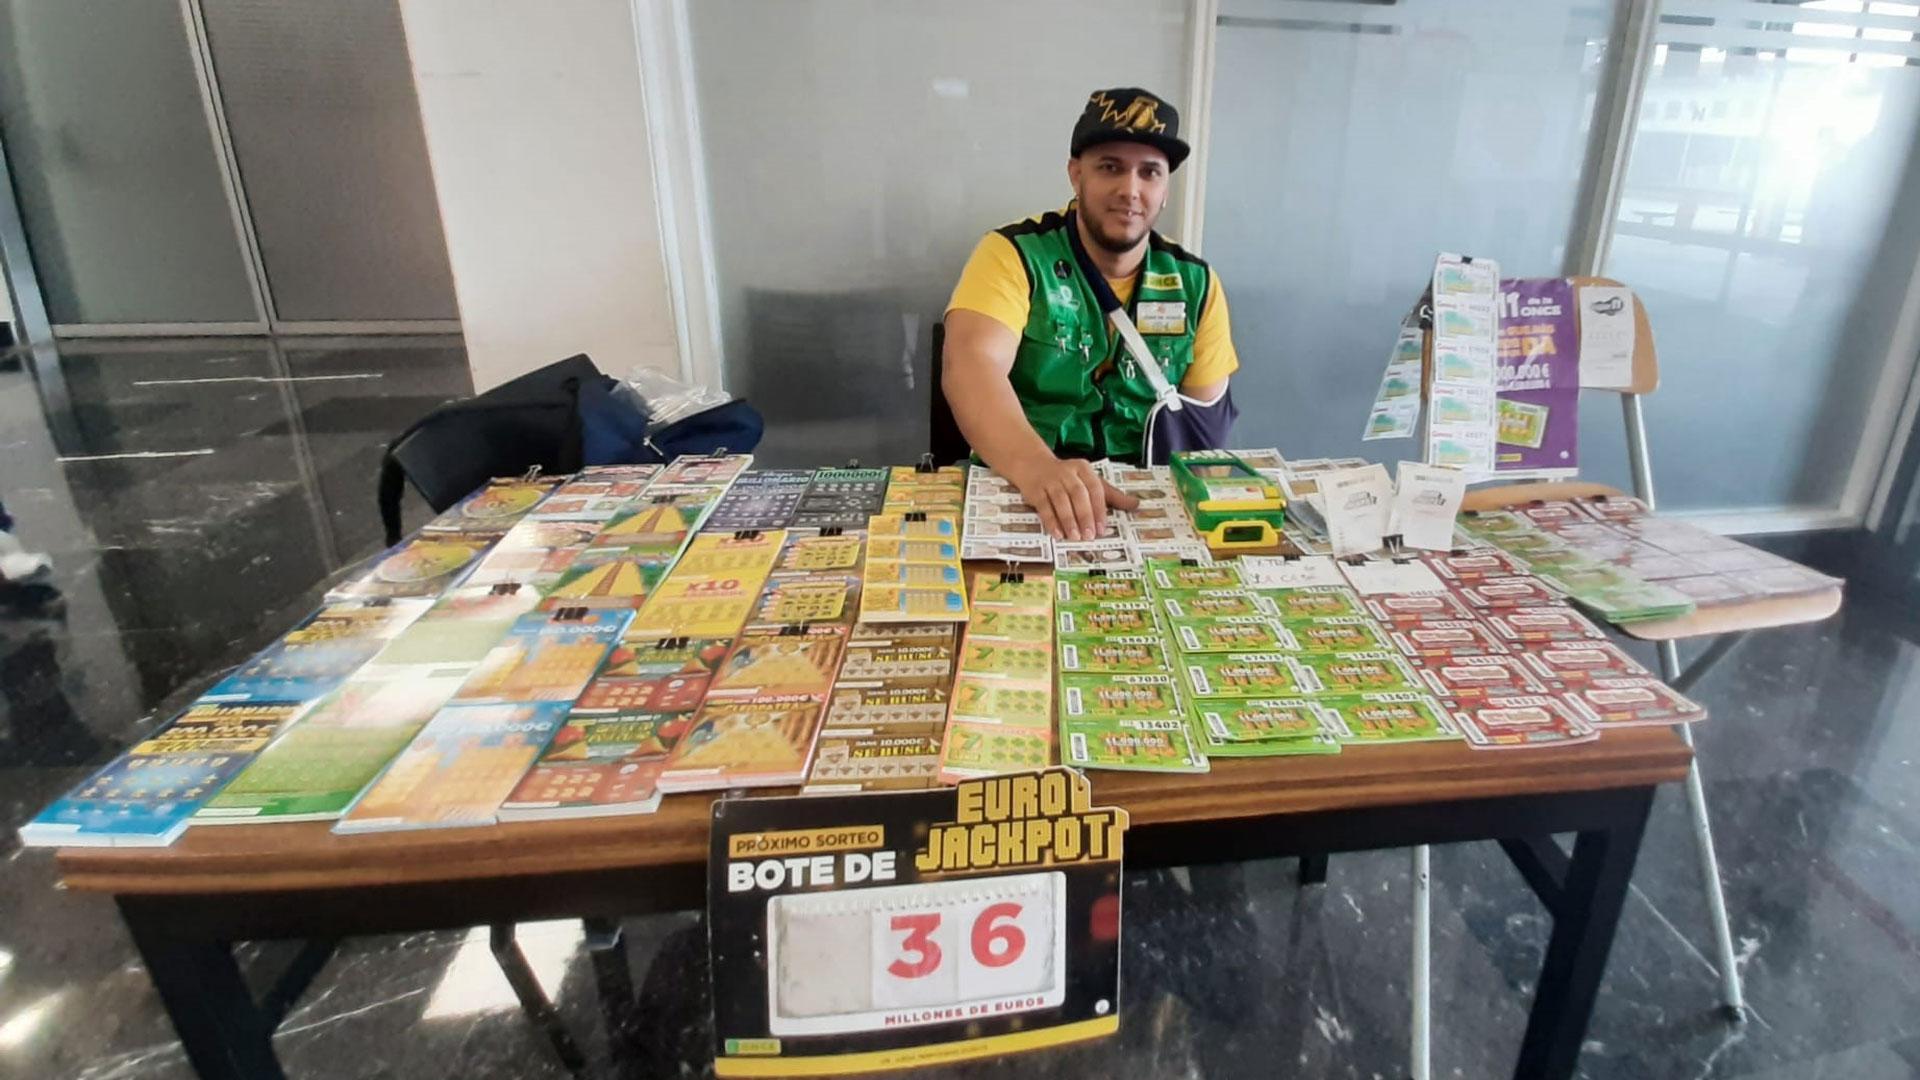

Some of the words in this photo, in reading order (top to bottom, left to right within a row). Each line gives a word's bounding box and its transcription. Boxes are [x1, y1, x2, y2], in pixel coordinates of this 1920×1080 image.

[1521, 305, 1561, 316] ONCE
[687, 579, 740, 592] x10
[957, 771, 1067, 824] EURO
[736, 836, 811, 853] PRÓXIMO
[816, 831, 880, 848] SORTEO
[915, 813, 1110, 871] JACKPOT
[728, 855, 835, 893] BOTE
[844, 851, 897, 883] DE
[884, 1007, 963, 1026] MILLONES
[969, 1003, 989, 1015] DE
[994, 996, 1045, 1013] EUROS
